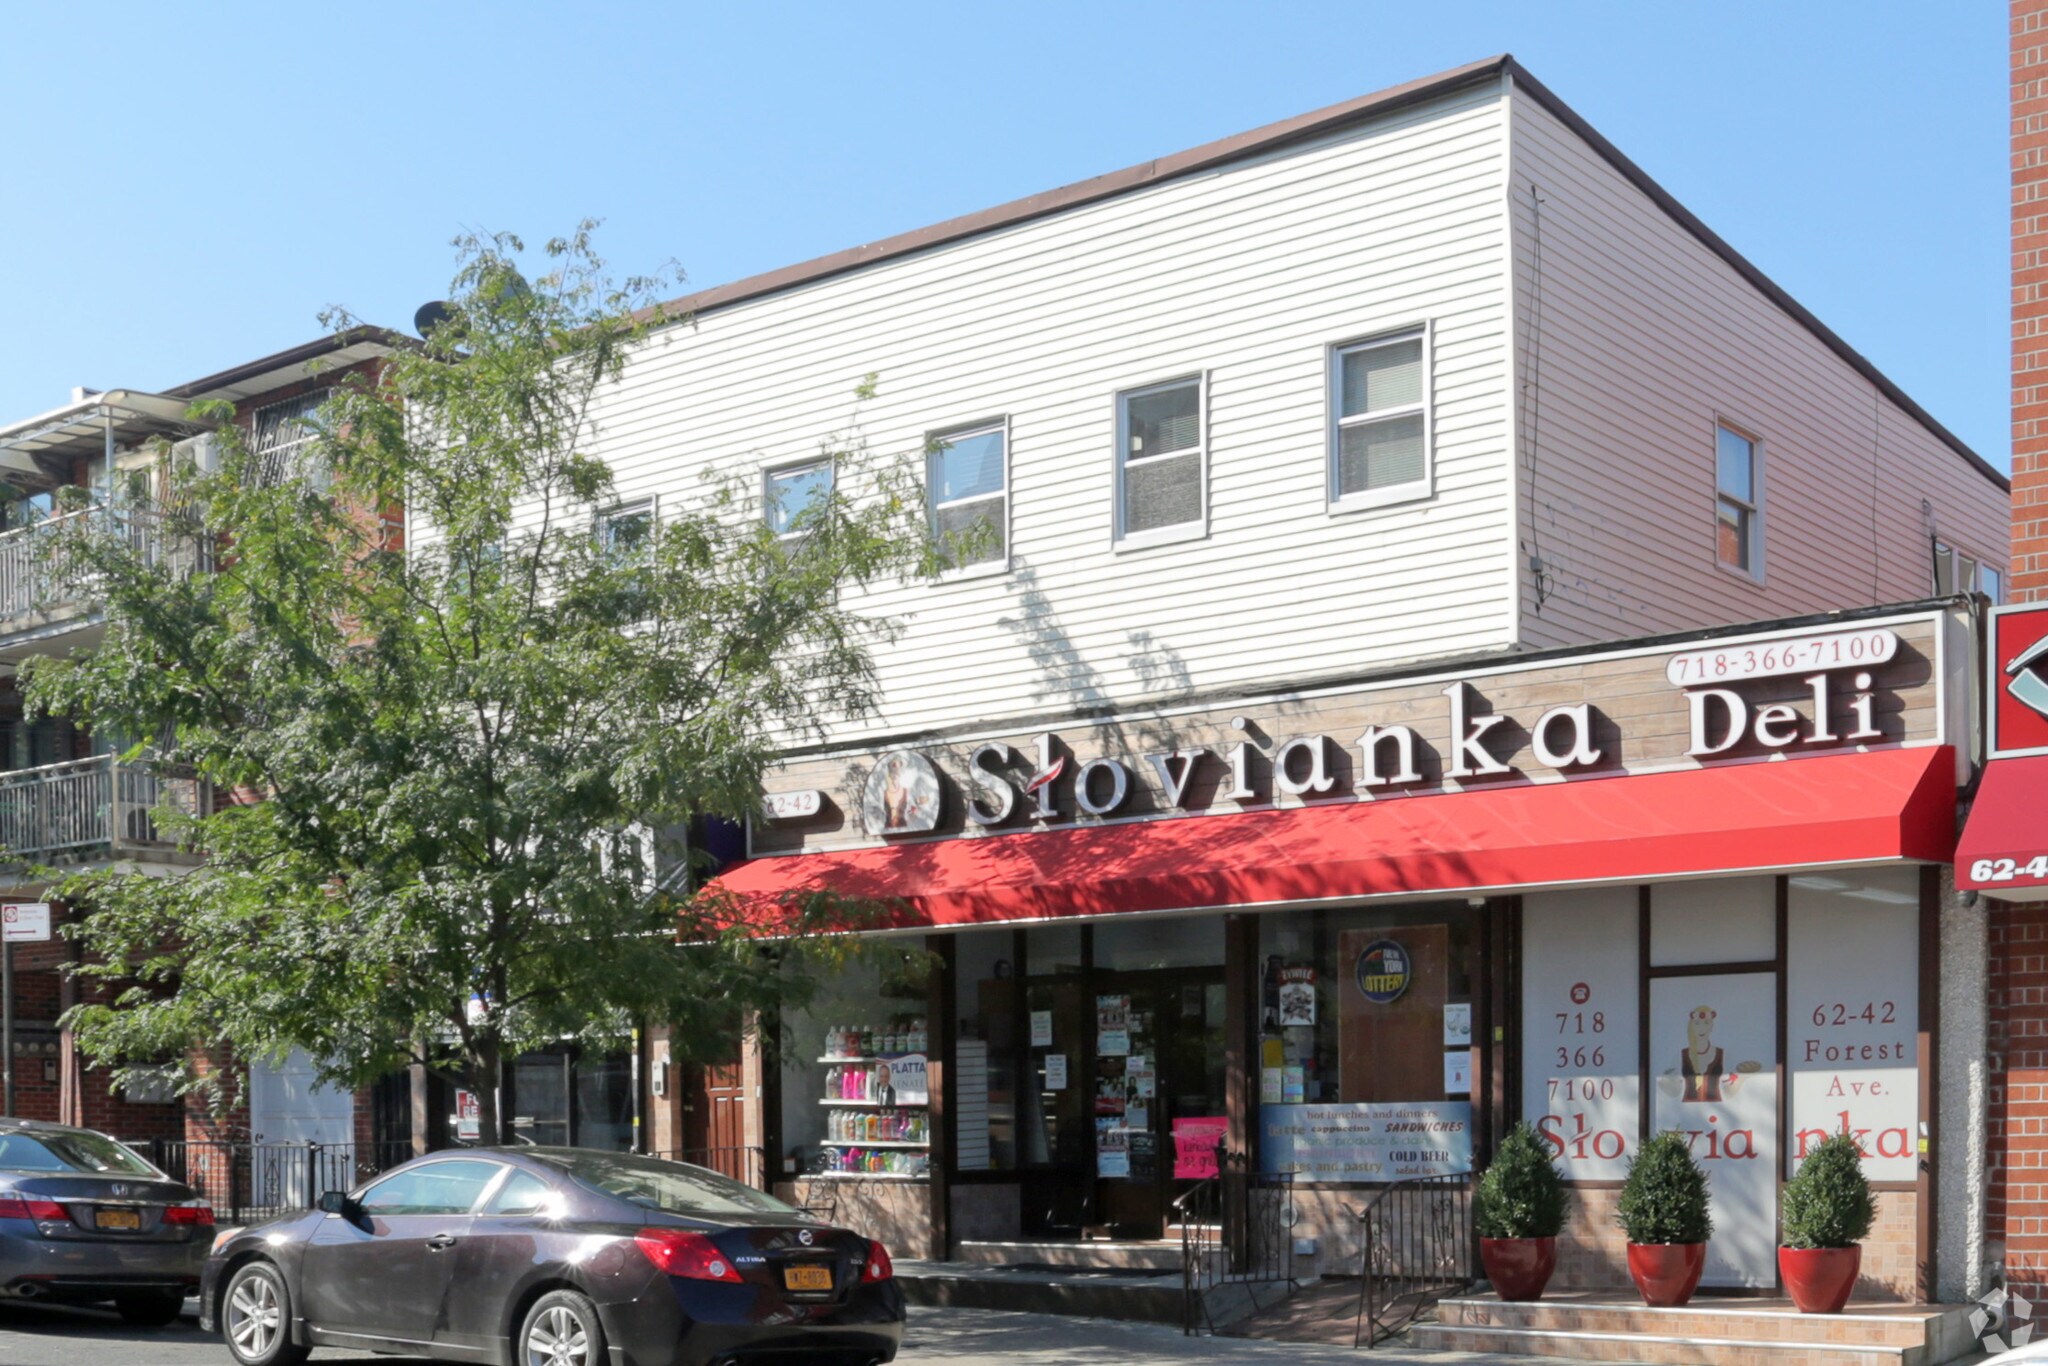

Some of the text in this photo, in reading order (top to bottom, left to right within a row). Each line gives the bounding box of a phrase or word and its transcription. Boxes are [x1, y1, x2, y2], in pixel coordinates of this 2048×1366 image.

[1675, 633, 1886, 681] 718-366-7100
[1682, 671, 1882, 757] Deli
[1362, 973, 1406, 994] LOTTERY
[1555, 1012, 1606, 1035] 718
[1812, 1001, 1896, 1027] 62-42
[1556, 1046, 1606, 1069] 366
[1803, 1039, 1905, 1063] Forest
[891, 1062, 926, 1074] PLATTA
[1546, 1079, 1614, 1101] 7100
[1825, 1074, 1891, 1098] Ave.
[1307, 1108, 1438, 1120] hot lunches and dinners
[1311, 1124, 1370, 1134] cappuccino
[1384, 1122, 1463, 1133] SANDWICHES
[1335, 1134, 1385, 1147] produce
[1389, 1150, 1418, 1162] COLD
[1421, 1150, 1449, 1162] BEER
[1316, 1161, 1338, 1172] and
[1344, 1161, 1383, 1174] pastry
